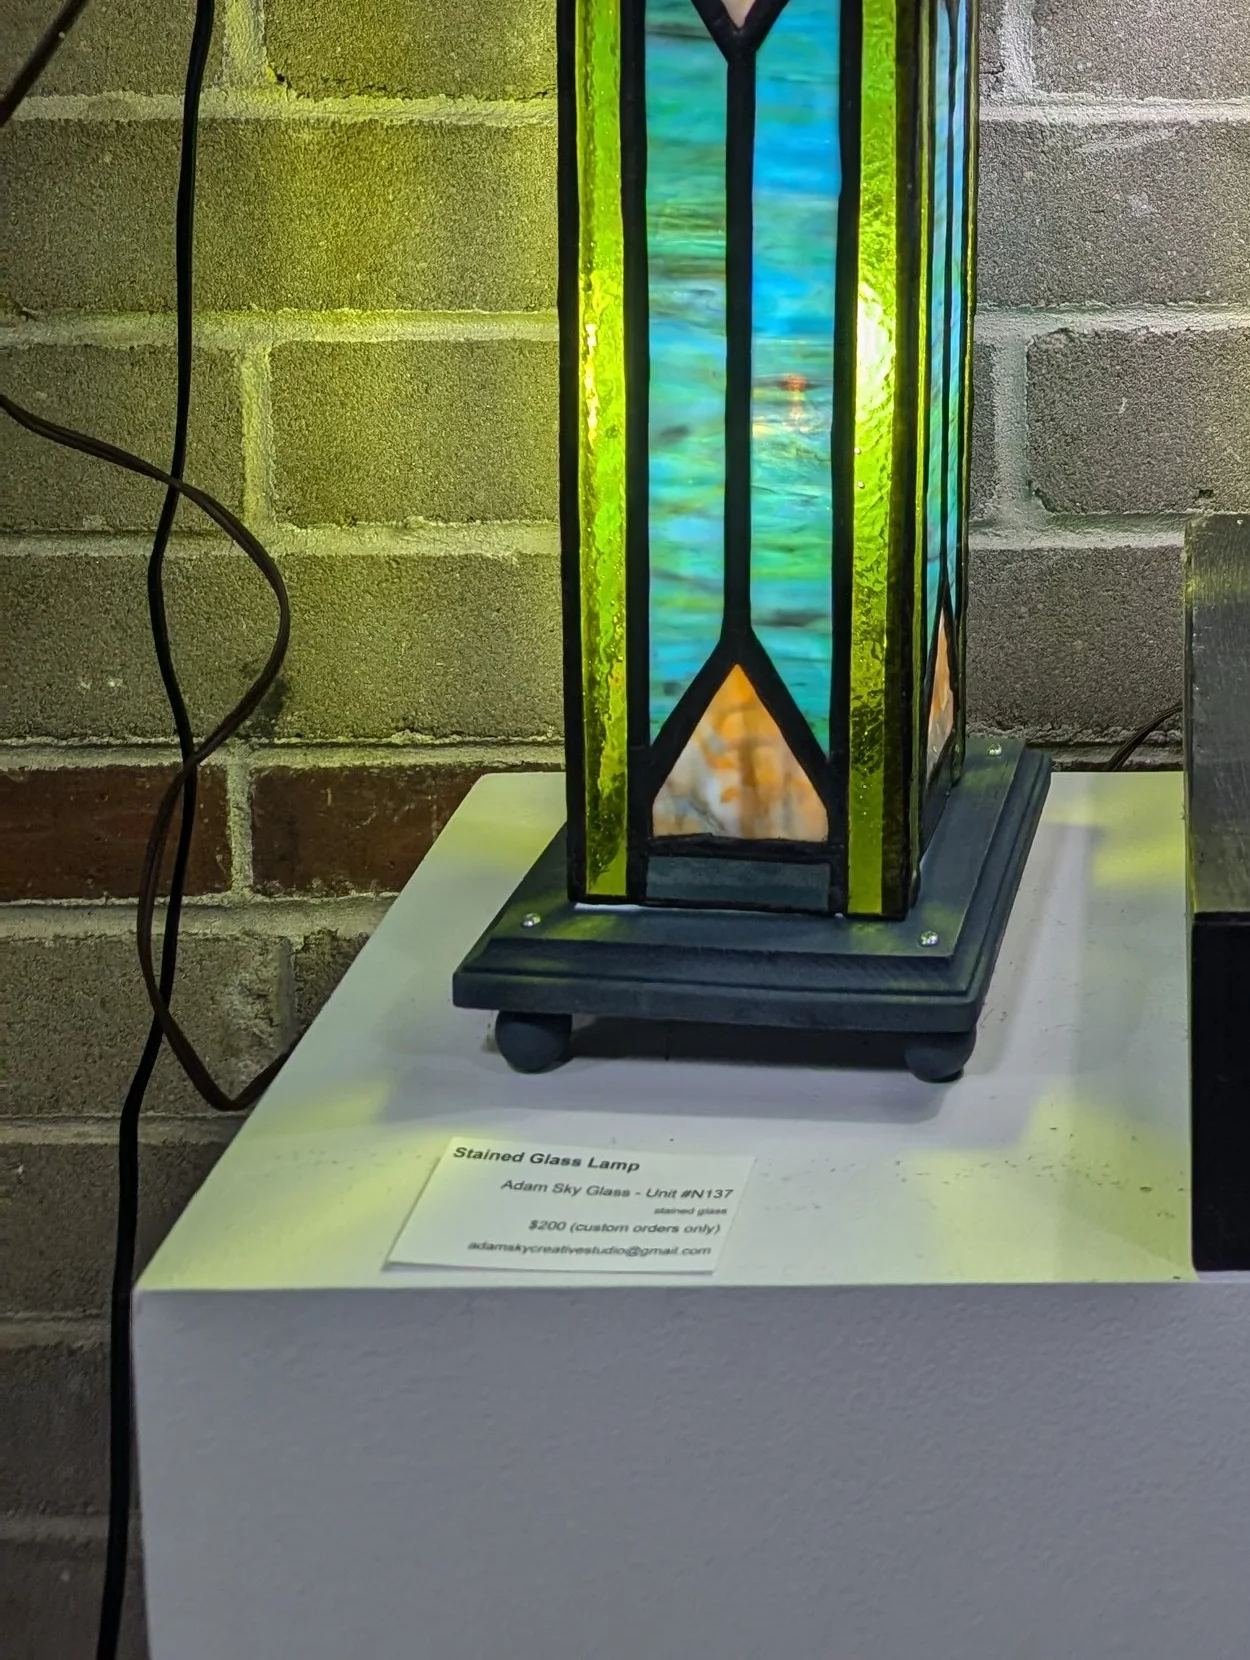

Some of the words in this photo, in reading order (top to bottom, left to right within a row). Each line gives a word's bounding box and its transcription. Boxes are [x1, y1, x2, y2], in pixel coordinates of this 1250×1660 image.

[453, 1146, 525, 1163] Stained
[529, 1152, 582, 1168] Glass
[587, 1156, 640, 1173] Lamp
[500, 1179, 548, 1193] Adam
[552, 1182, 582, 1198] Sky
[586, 1185, 631, 1198] Glass
[646, 1188, 677, 1199] Unit
[680, 1189, 733, 1199] #N137
[653, 1207, 695, 1215] stained
[696, 1207, 728, 1217] glass
[528, 1219, 567, 1231] $200
[569, 1222, 629, 1234] (custom
[632, 1224, 680, 1234] orders
[683, 1223, 721, 1235] only)
